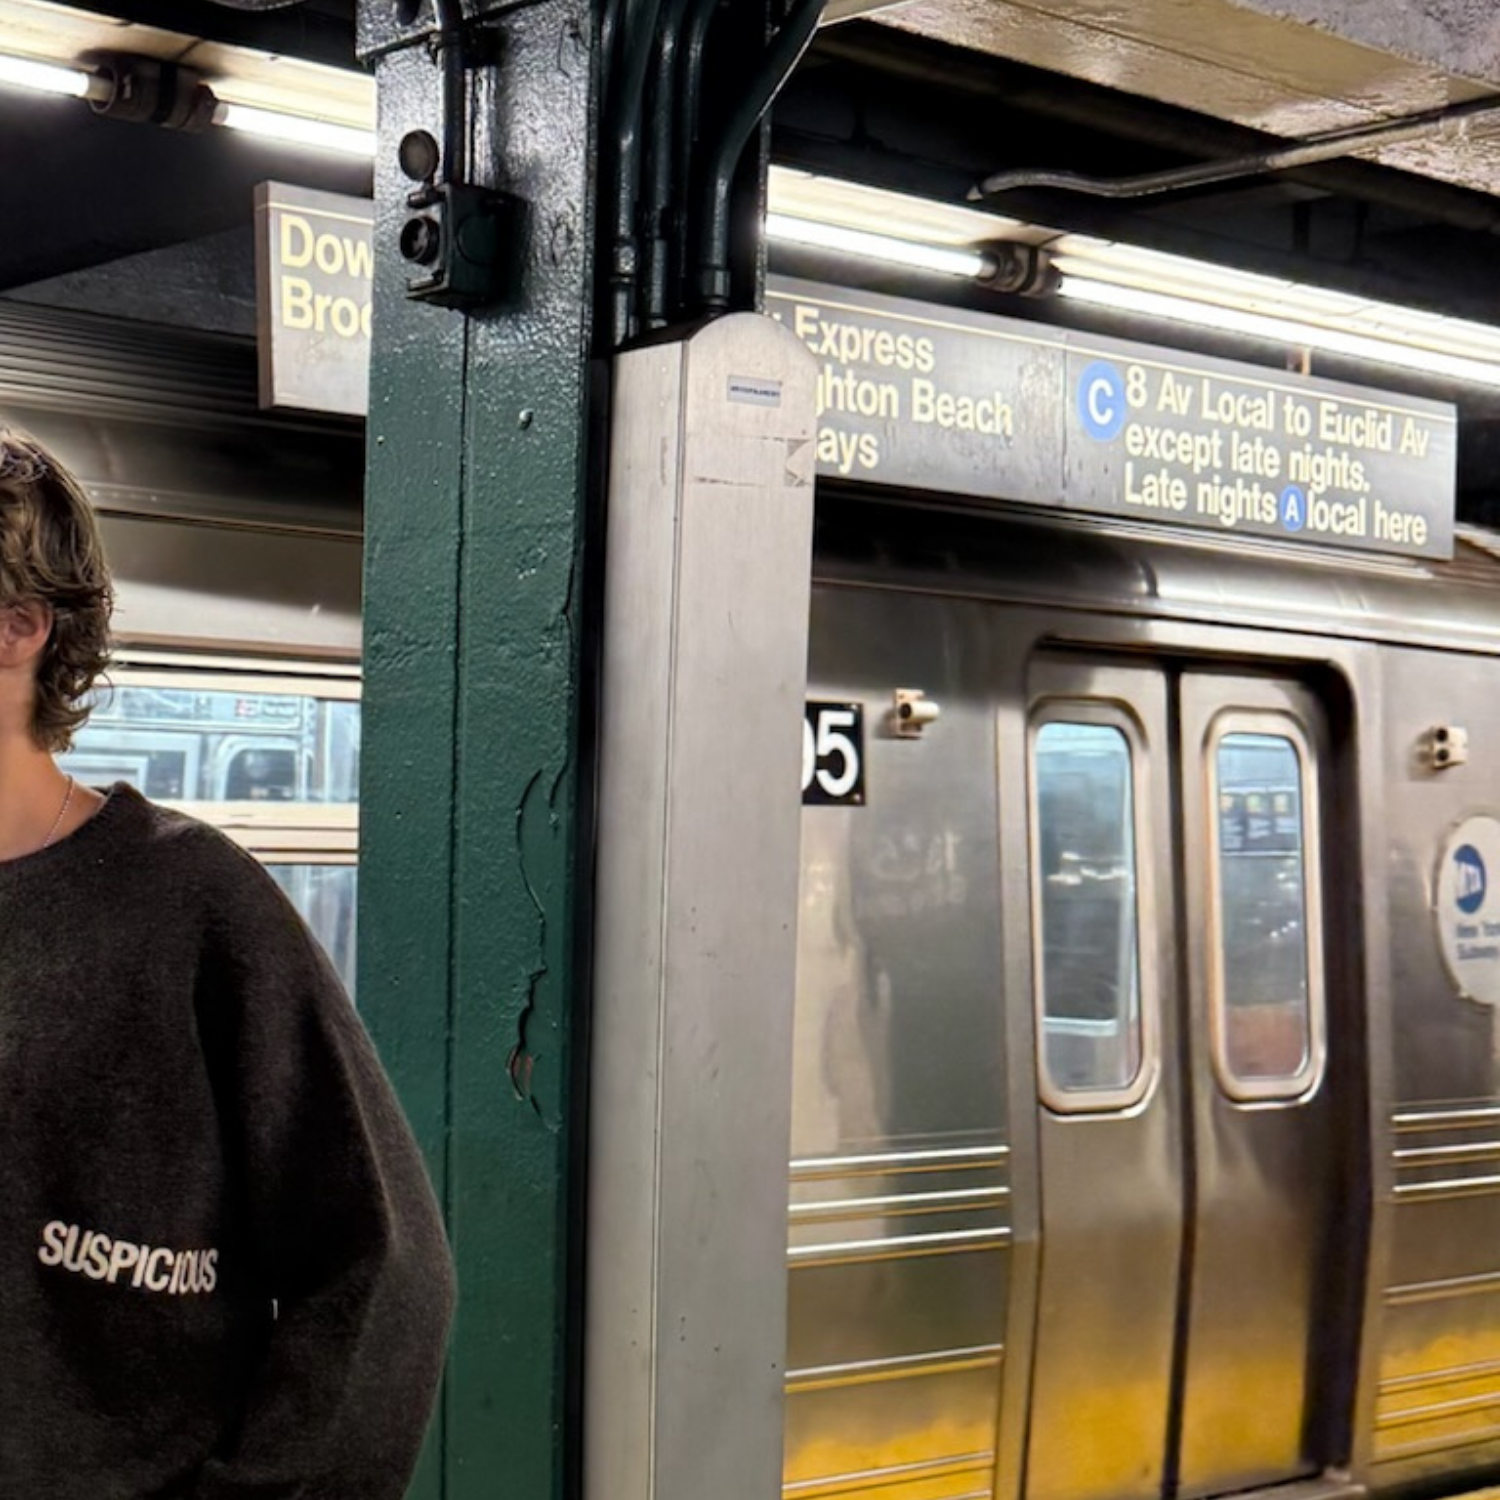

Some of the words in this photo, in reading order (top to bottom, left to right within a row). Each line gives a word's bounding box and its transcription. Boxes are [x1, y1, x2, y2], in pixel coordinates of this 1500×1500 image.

[280, 213, 375, 280] Dow
[794, 304, 935, 373] Express
[911, 376, 1013, 438] Beach
[1087, 377, 1115, 427] C
[1125, 364, 1148, 409] 8
[1156, 370, 1194, 417] Av
[1201, 378, 1276, 432] Local
[1282, 395, 1312, 438] to
[1318, 400, 1392, 451] Euclid
[1399, 416, 1431, 459] Av
[1124, 422, 1223, 475] except
[1231, 430, 1281, 480] late
[1288, 442, 1371, 495] nights.
[1124, 460, 1188, 512] Late
[1197, 473, 1277, 528] nights
[1284, 493, 1301, 524] A
[1306, 488, 1367, 536] local
[1373, 499, 1429, 546] here
[37, 1219, 220, 1295] SUSPICIOUS
